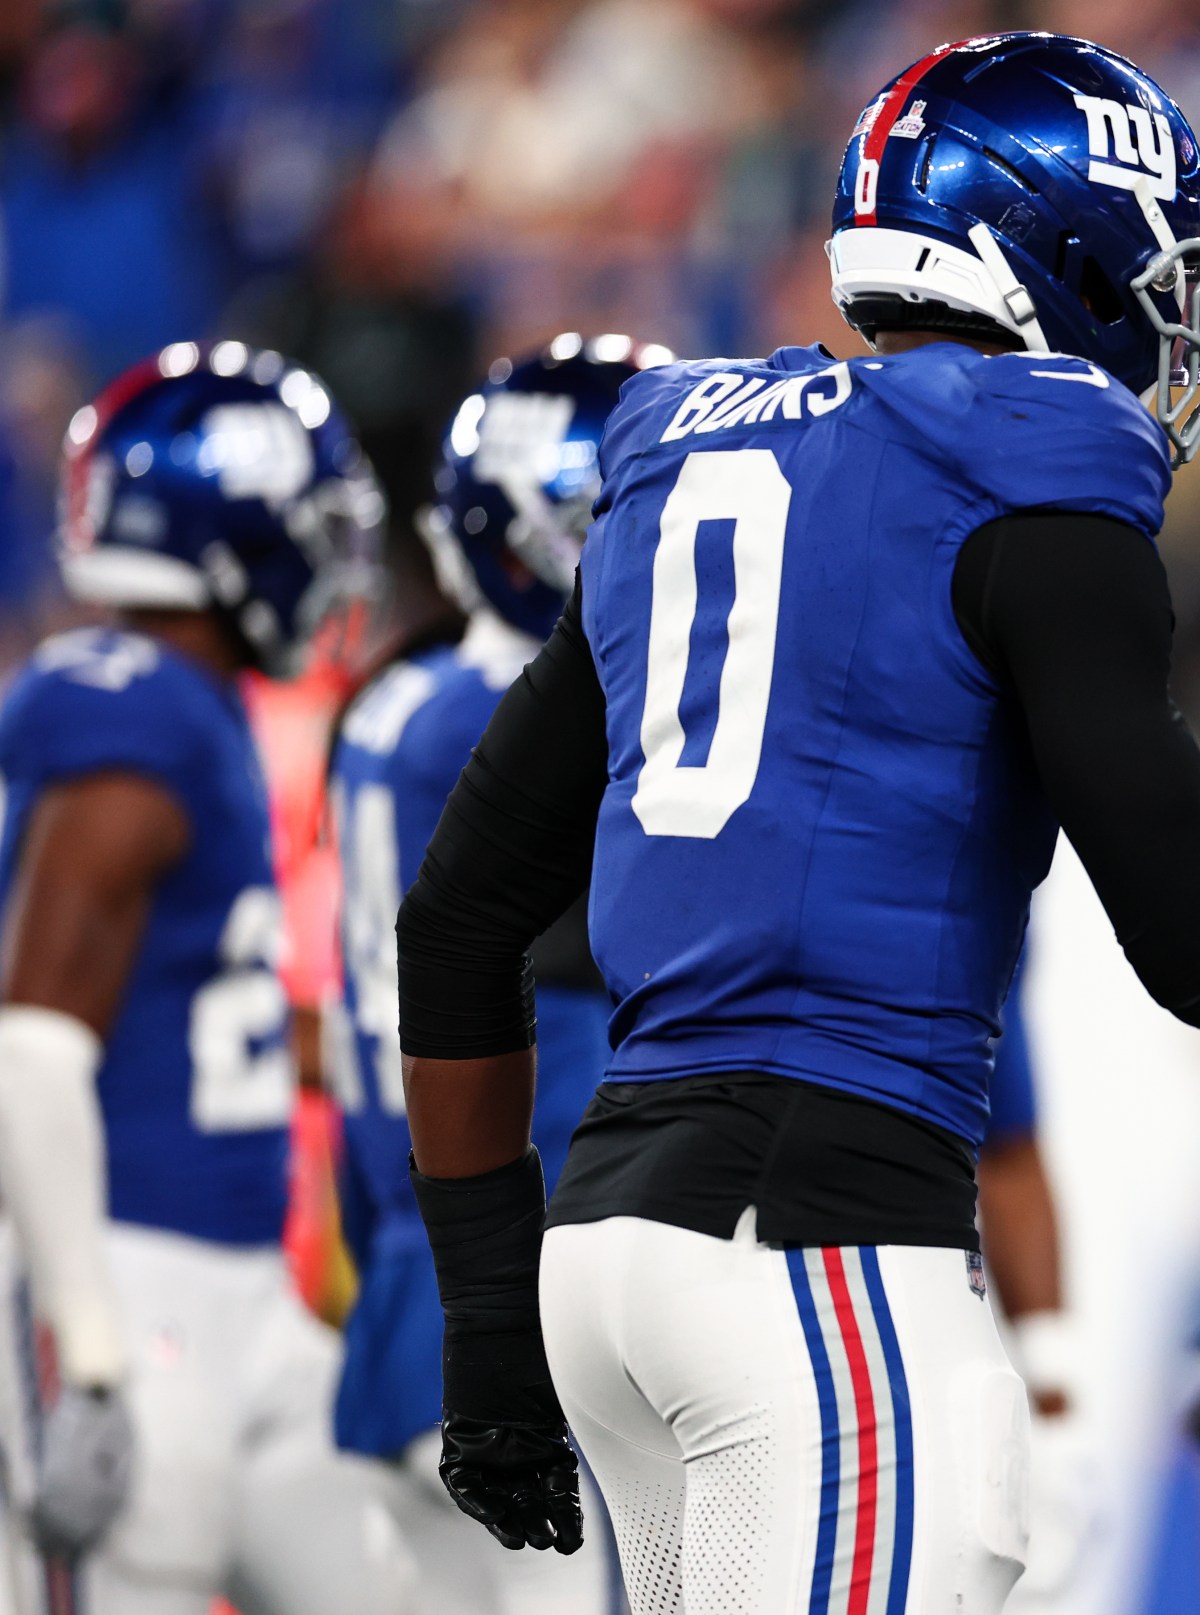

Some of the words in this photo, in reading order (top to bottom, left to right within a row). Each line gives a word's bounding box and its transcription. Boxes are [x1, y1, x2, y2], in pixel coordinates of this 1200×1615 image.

[854, 158, 879, 215] 0
[1074, 94, 1177, 201] ny
[631, 449, 792, 838] 0
